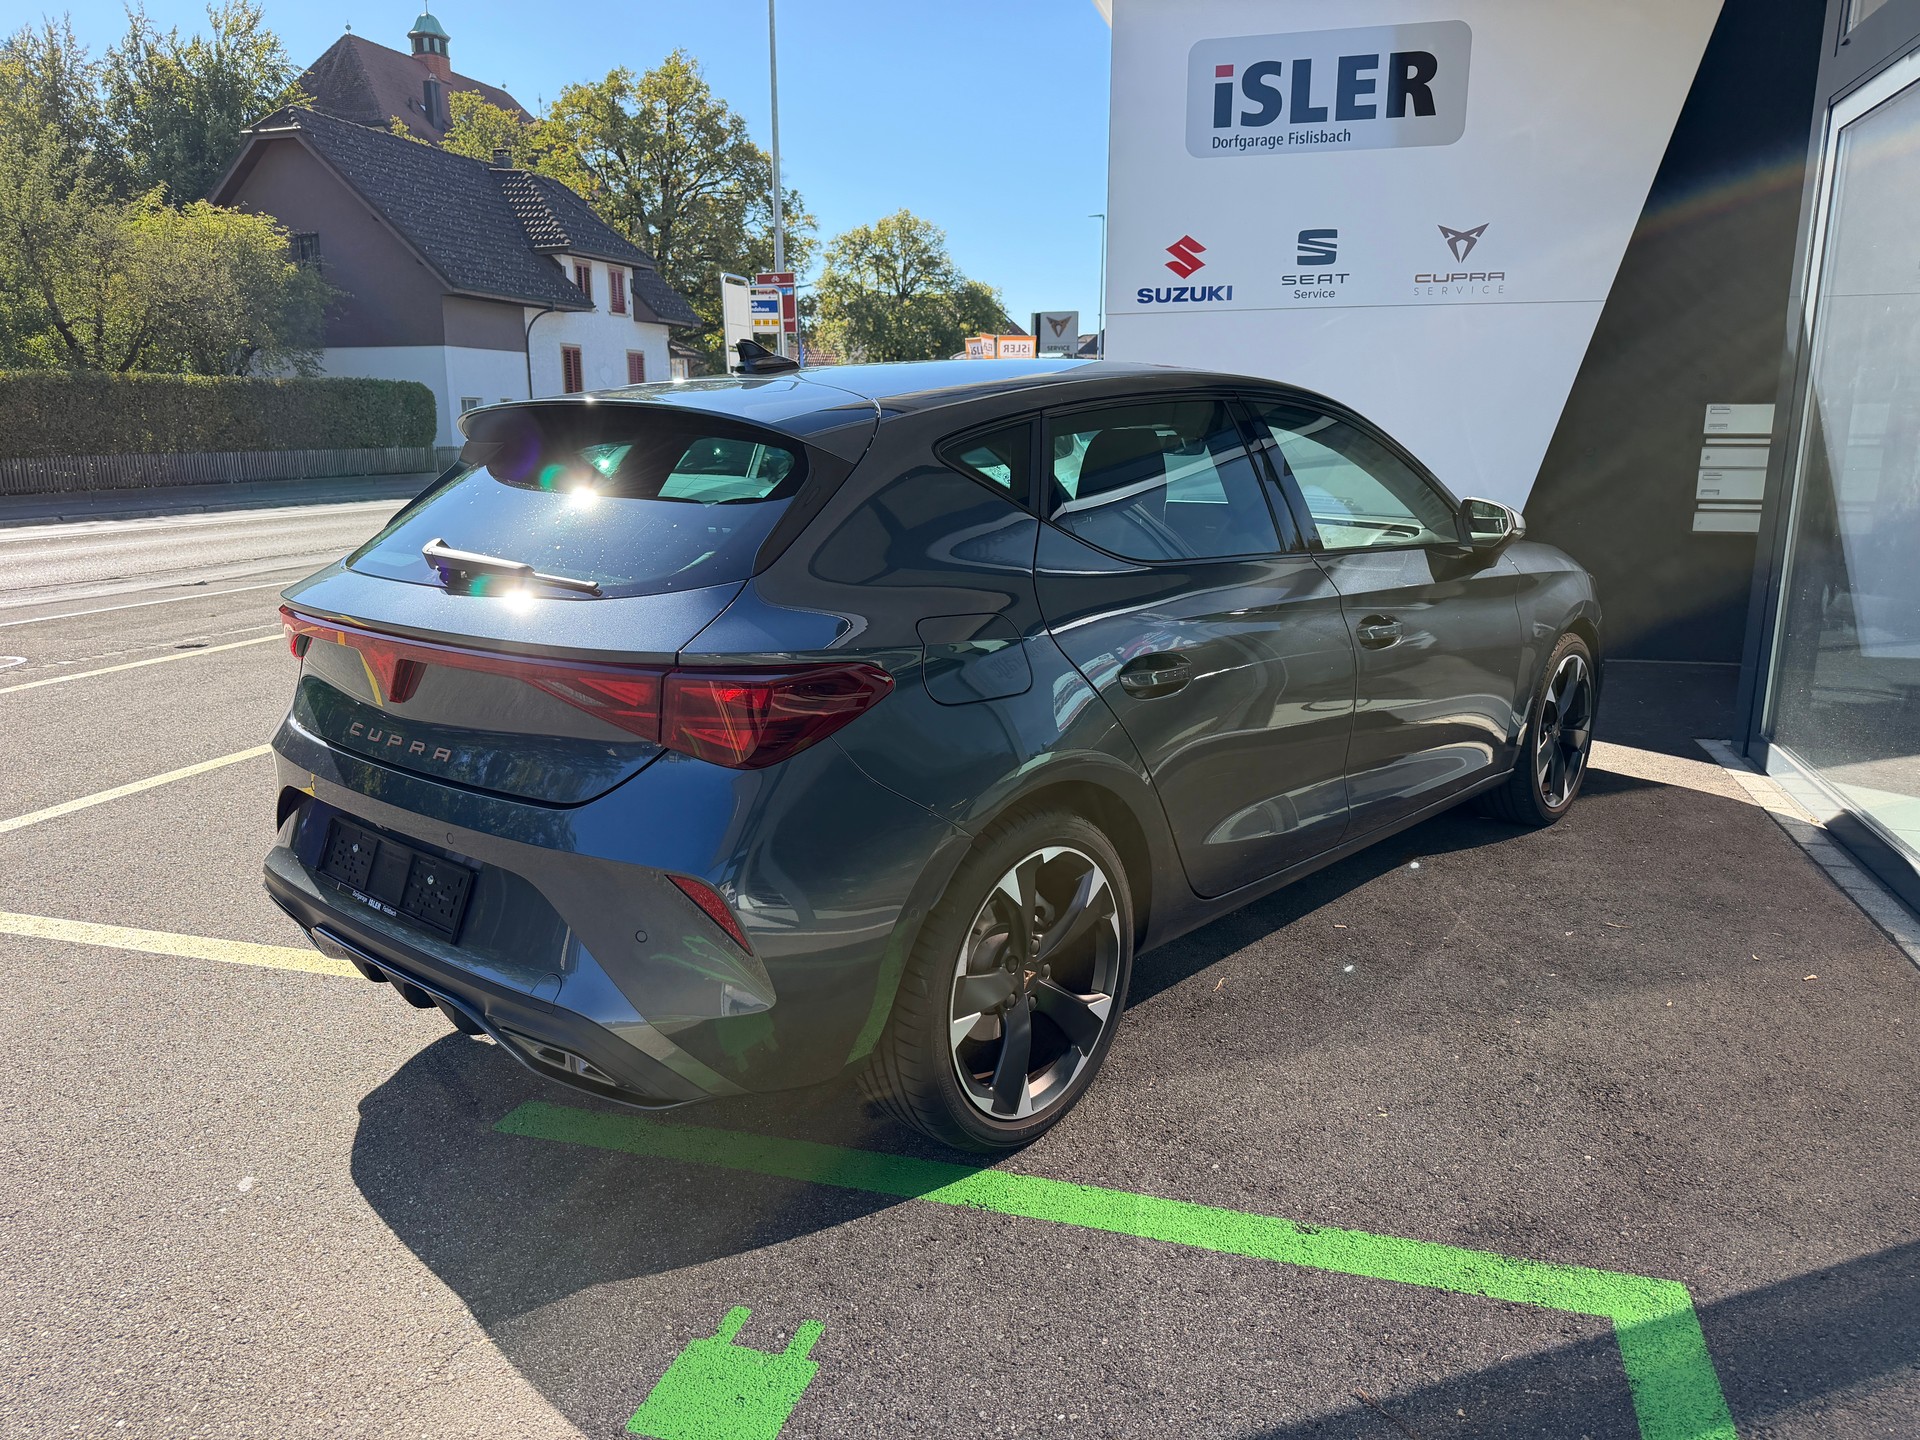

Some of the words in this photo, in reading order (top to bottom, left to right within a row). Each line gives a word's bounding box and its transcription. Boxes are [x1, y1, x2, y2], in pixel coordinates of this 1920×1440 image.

[1212, 133, 1284, 151] Dorfgarage
[1288, 128, 1352, 145] Fislisbach
[1281, 273, 1350, 286] SEAT
[1414, 271, 1506, 284] CUPRA
[1136, 285, 1233, 304] SUZUKI
[1293, 288, 1336, 300] Service
[1413, 284, 1504, 296] SERVICE
[349, 721, 452, 763] CUPRA
